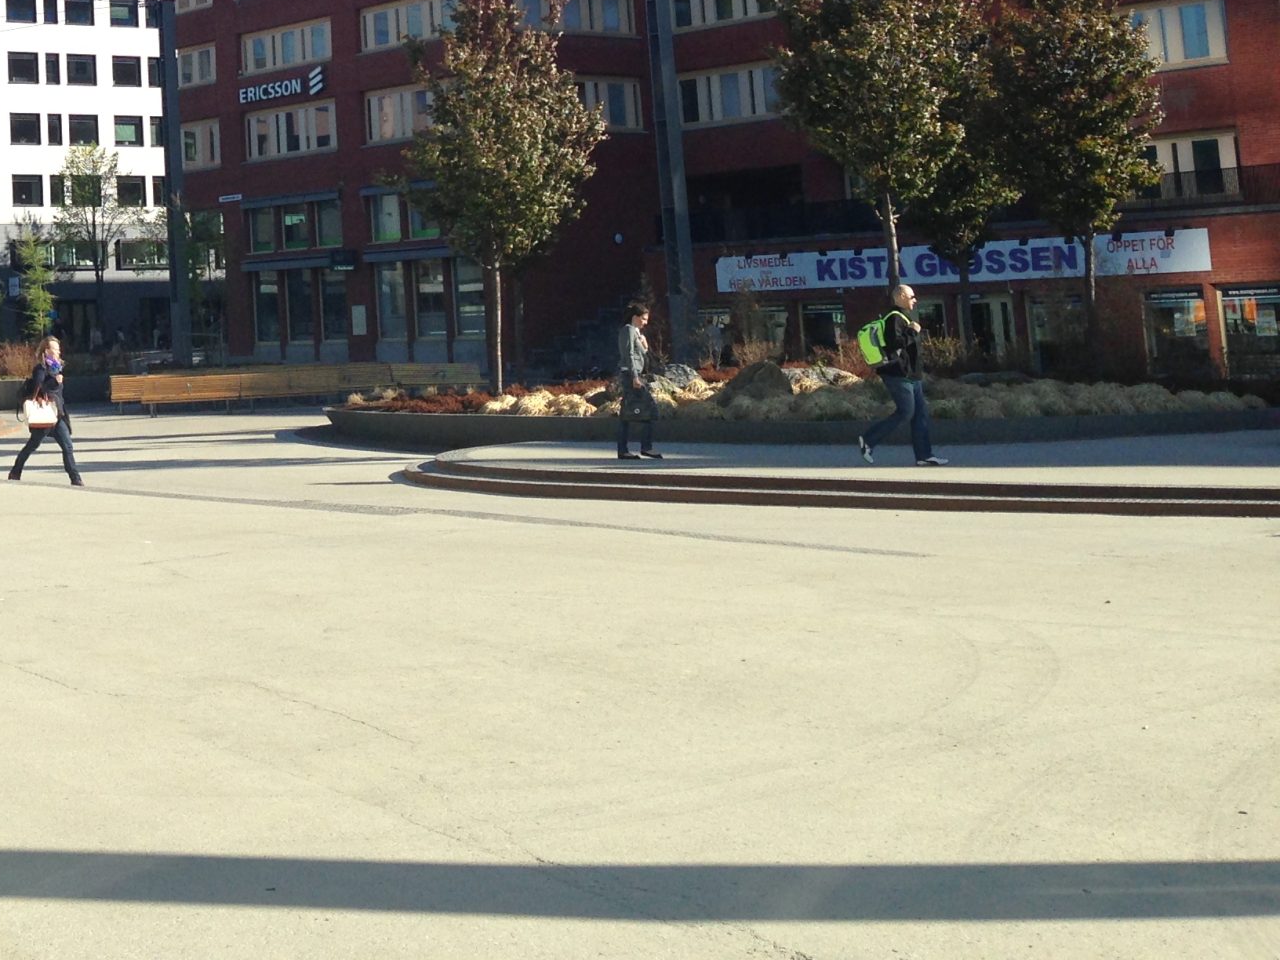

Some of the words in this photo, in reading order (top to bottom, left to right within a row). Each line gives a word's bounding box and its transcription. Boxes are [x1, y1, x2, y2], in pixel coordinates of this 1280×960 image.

[240, 79, 301, 103] ERICSSON
[1149, 236, 1175, 251] FÖR
[737, 257, 794, 270] LIVSMEDEL
[1127, 257, 1158, 270] ALLA
[729, 279, 757, 290] HEA
[758, 275, 807, 288] VÄRLDEN
